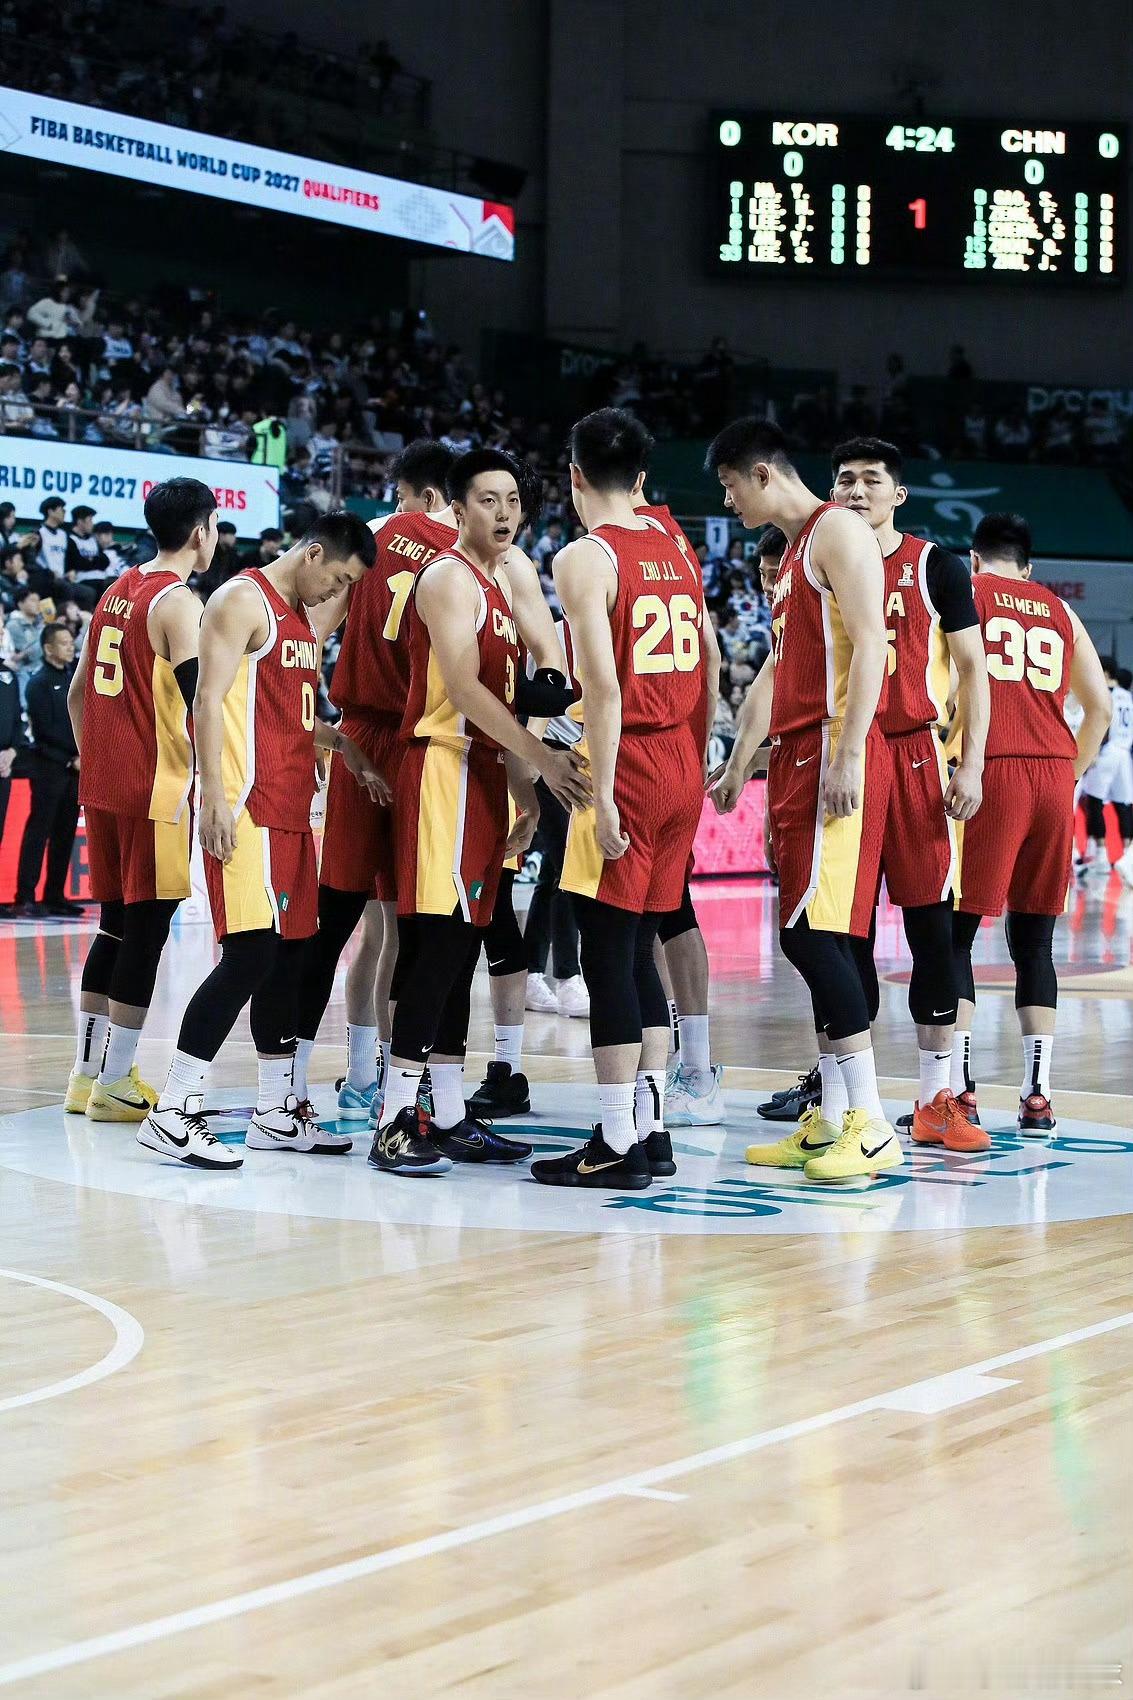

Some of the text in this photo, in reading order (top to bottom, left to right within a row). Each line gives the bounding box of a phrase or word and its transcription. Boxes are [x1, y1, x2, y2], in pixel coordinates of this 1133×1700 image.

[720, 120, 741, 146] 0
[772, 122, 839, 147] KOR
[886, 125, 955, 152] 4:24
[1001, 129, 1065, 154] CHN
[1099, 133, 1119, 158] 0
[30, 116, 380, 211] FIBA BASKETBALL WORLD CUP 2027 QUALIFIERS
[783, 151, 803, 177] 0
[1025, 159, 1044, 184] 0
[909, 198, 926, 229] 1
[42, 469, 82, 494] CUP
[88, 475, 137, 499] 2027
[387, 533, 423, 562] ZENG
[639, 561, 683, 581] ZHU J.L.
[102, 595, 127, 615] LIAO
[382, 570, 415, 641] 1
[632, 594, 700, 675] 26
[93, 625, 124, 697] 5
[281, 639, 318, 671] CHIN
[985, 616, 1065, 693] 39
[504, 654, 515, 704] 3
[301, 681, 315, 732] 0
